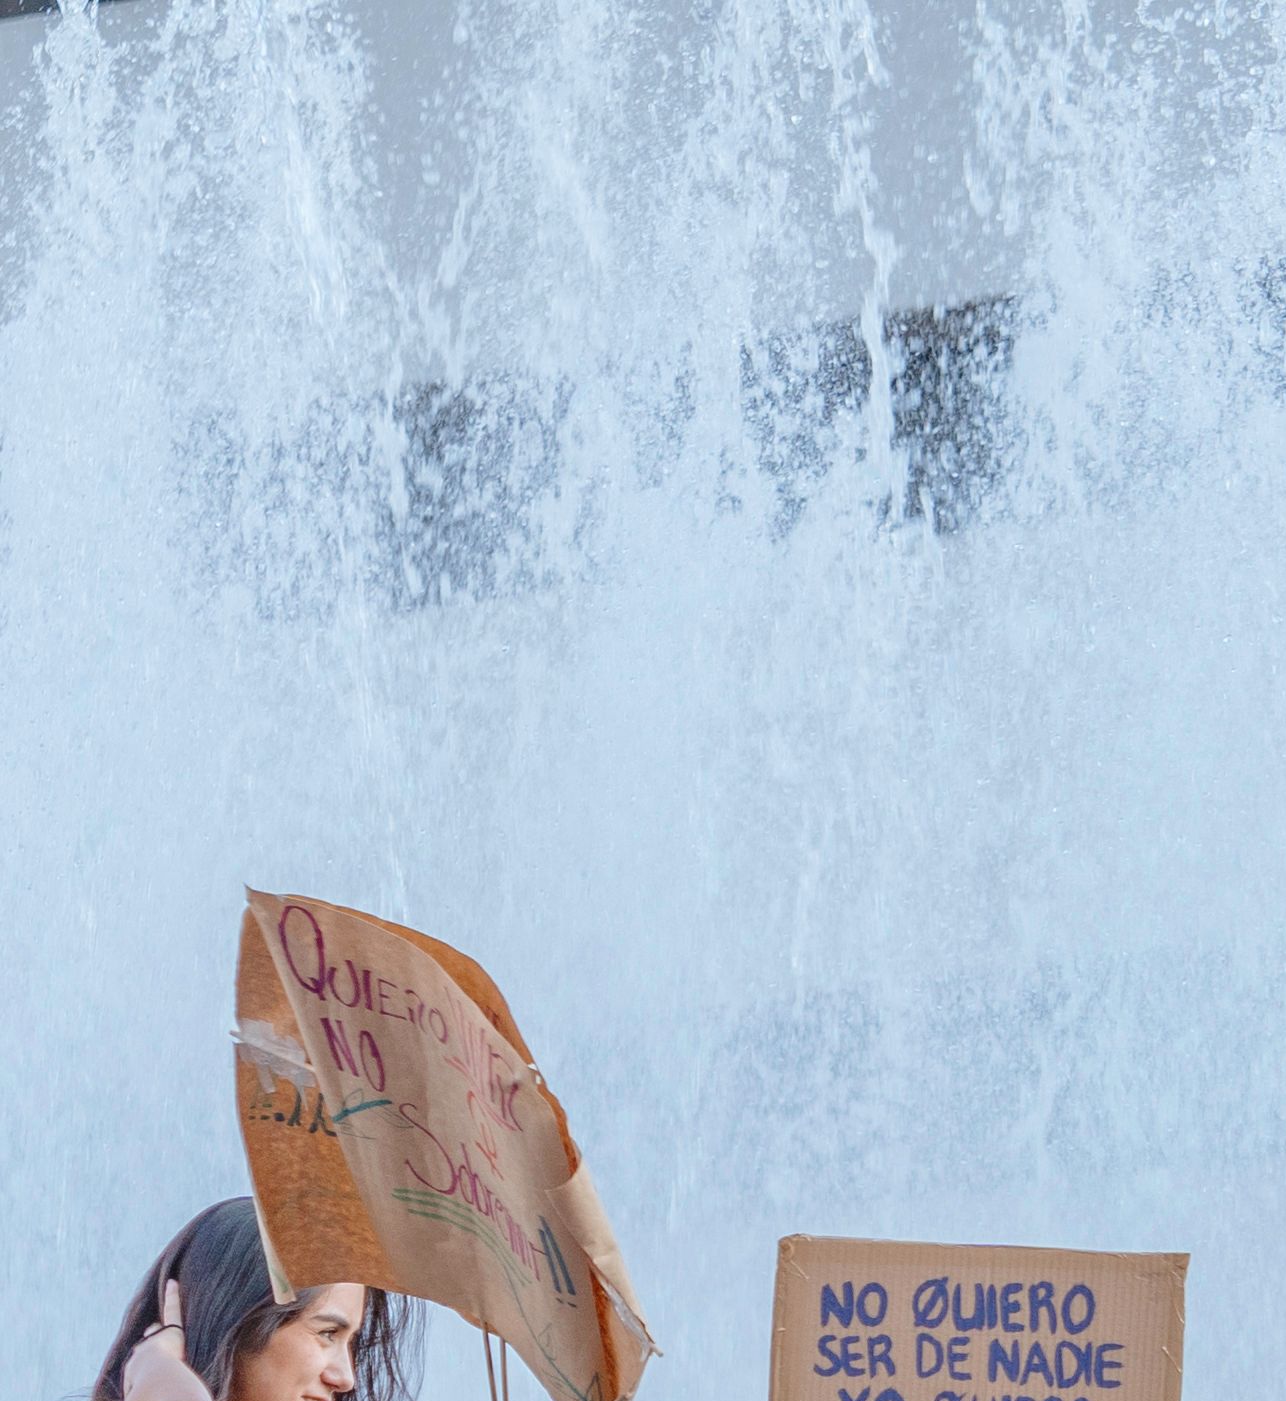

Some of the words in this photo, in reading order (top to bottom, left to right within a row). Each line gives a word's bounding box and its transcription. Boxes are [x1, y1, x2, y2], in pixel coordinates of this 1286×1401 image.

[319, 1015, 387, 1093] NO
[820, 1280, 888, 1329] NO
[813, 1334, 897, 1379] SER
[915, 1333, 972, 1381] DE
[988, 1338, 1126, 1389] NADIE
